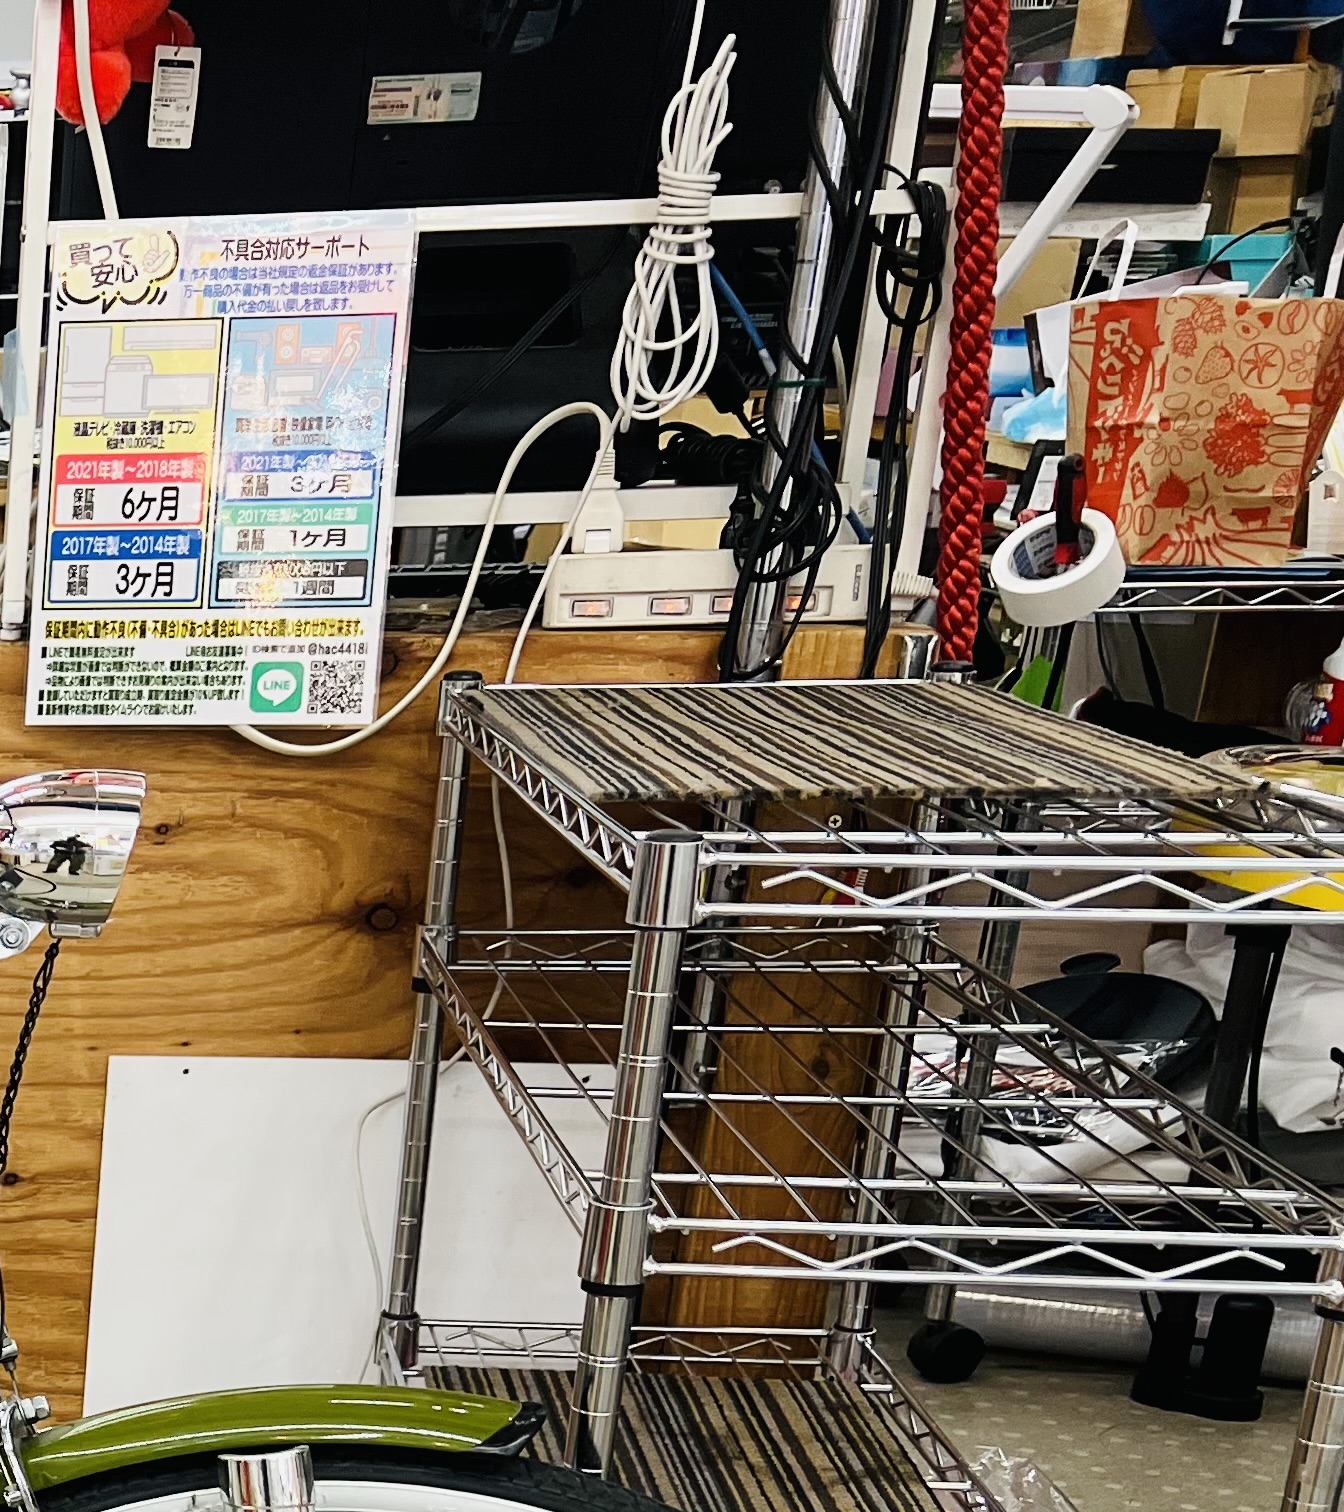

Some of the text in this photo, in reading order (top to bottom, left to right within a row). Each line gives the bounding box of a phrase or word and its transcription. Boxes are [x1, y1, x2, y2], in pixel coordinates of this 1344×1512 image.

[69, 237, 133, 268] 買って
[91, 262, 139, 288] 安心
[263, 679, 290, 691] LINE
